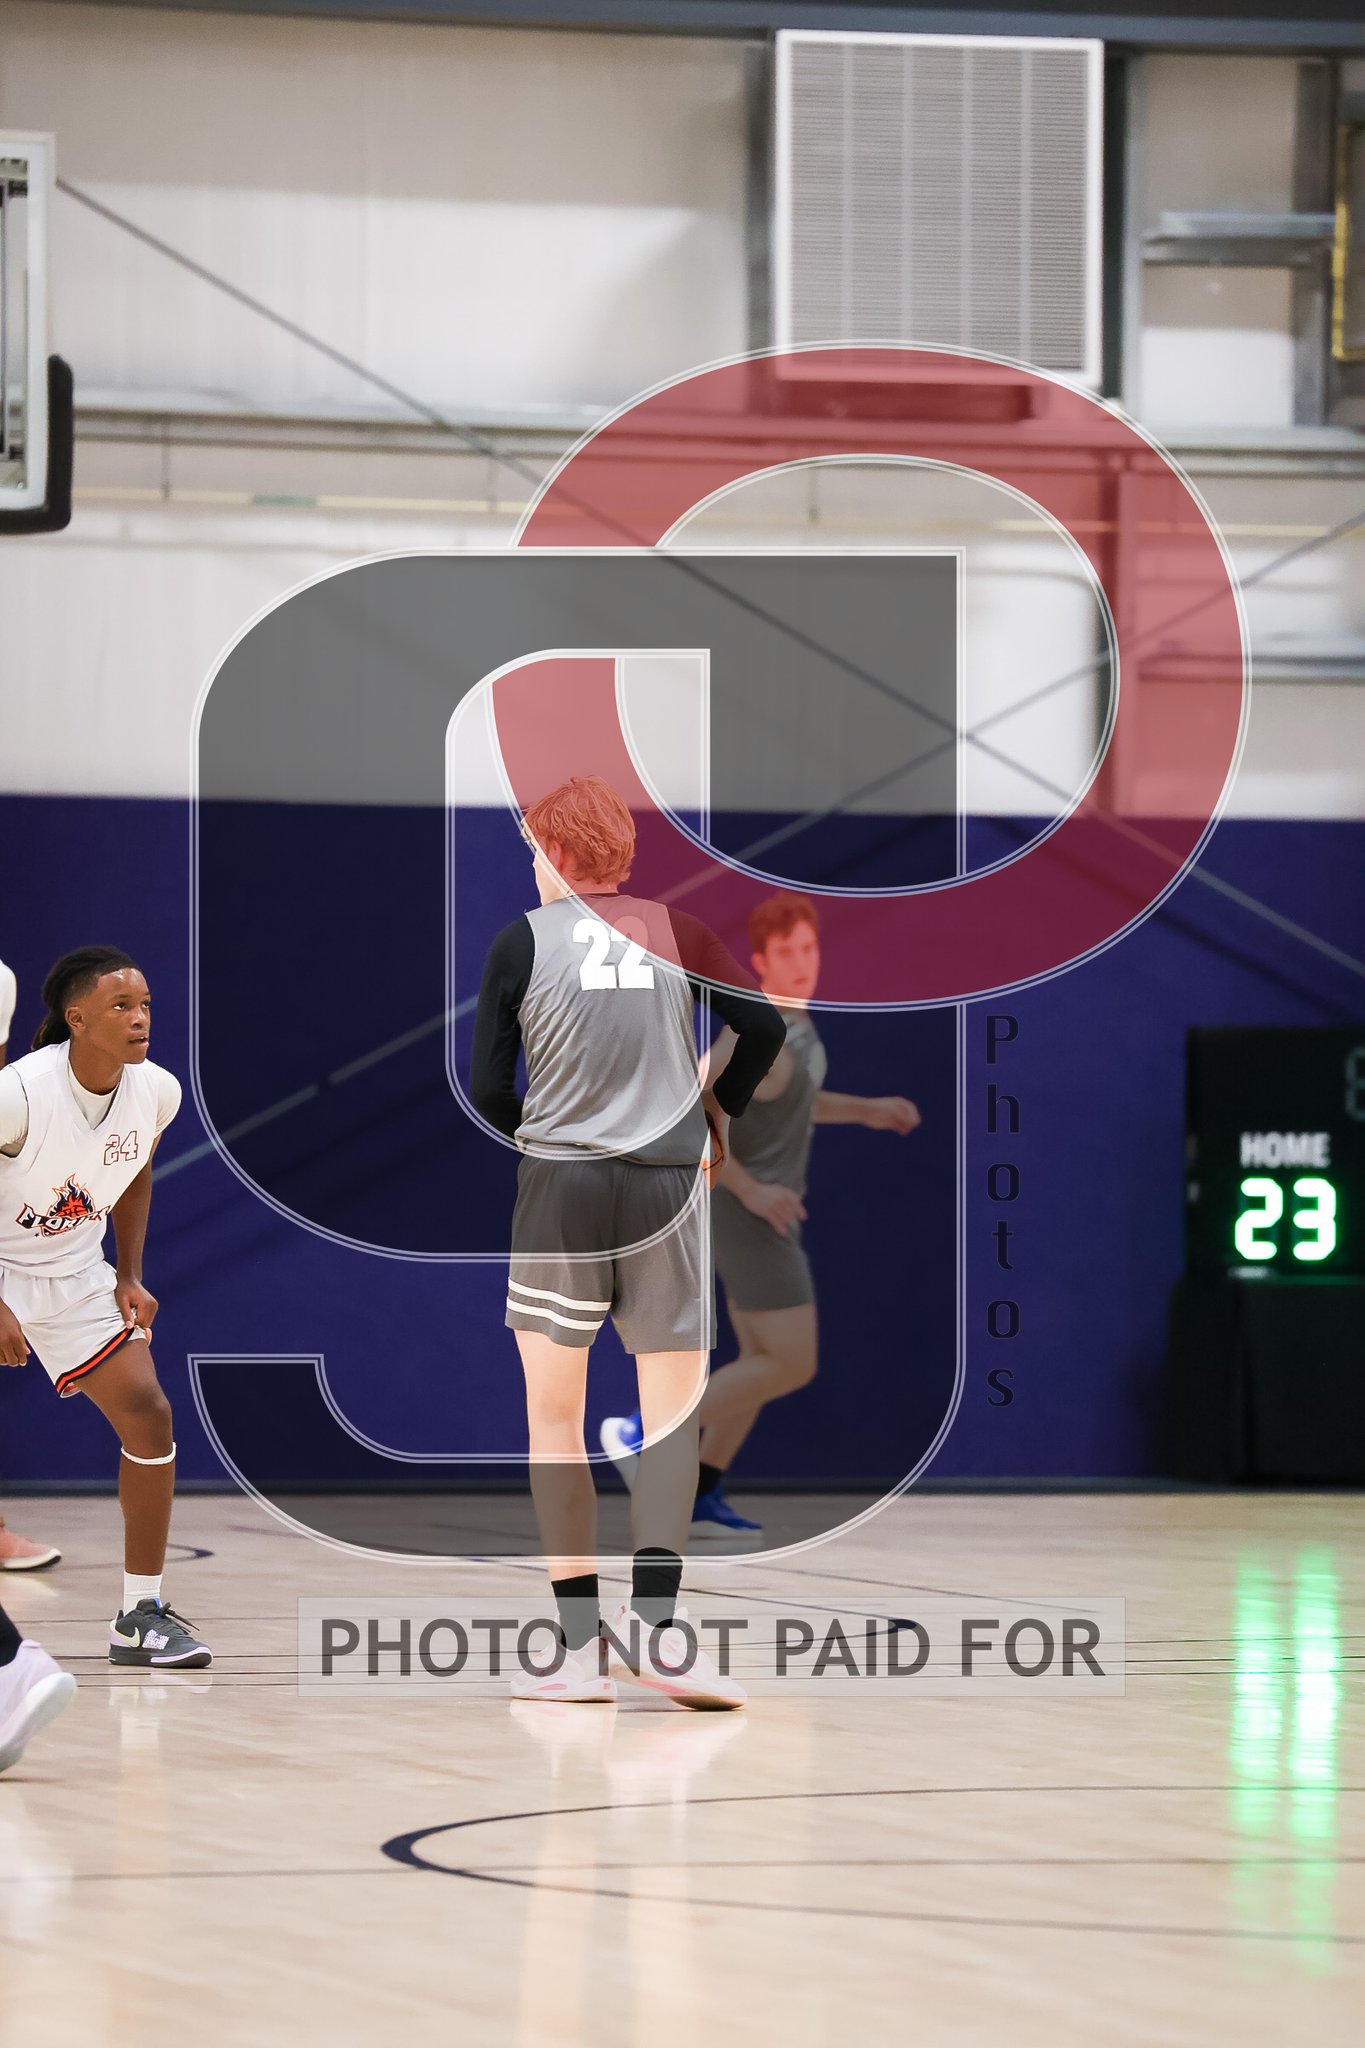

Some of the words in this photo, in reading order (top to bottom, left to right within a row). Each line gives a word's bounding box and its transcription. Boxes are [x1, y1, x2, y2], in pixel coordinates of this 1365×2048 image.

[572, 915, 655, 992] 22
[103, 1130, 139, 1166] 24
[1239, 1131, 1331, 1168] HOME
[15, 1202, 112, 1231] FLORI
[1234, 1177, 1337, 1261] 23
